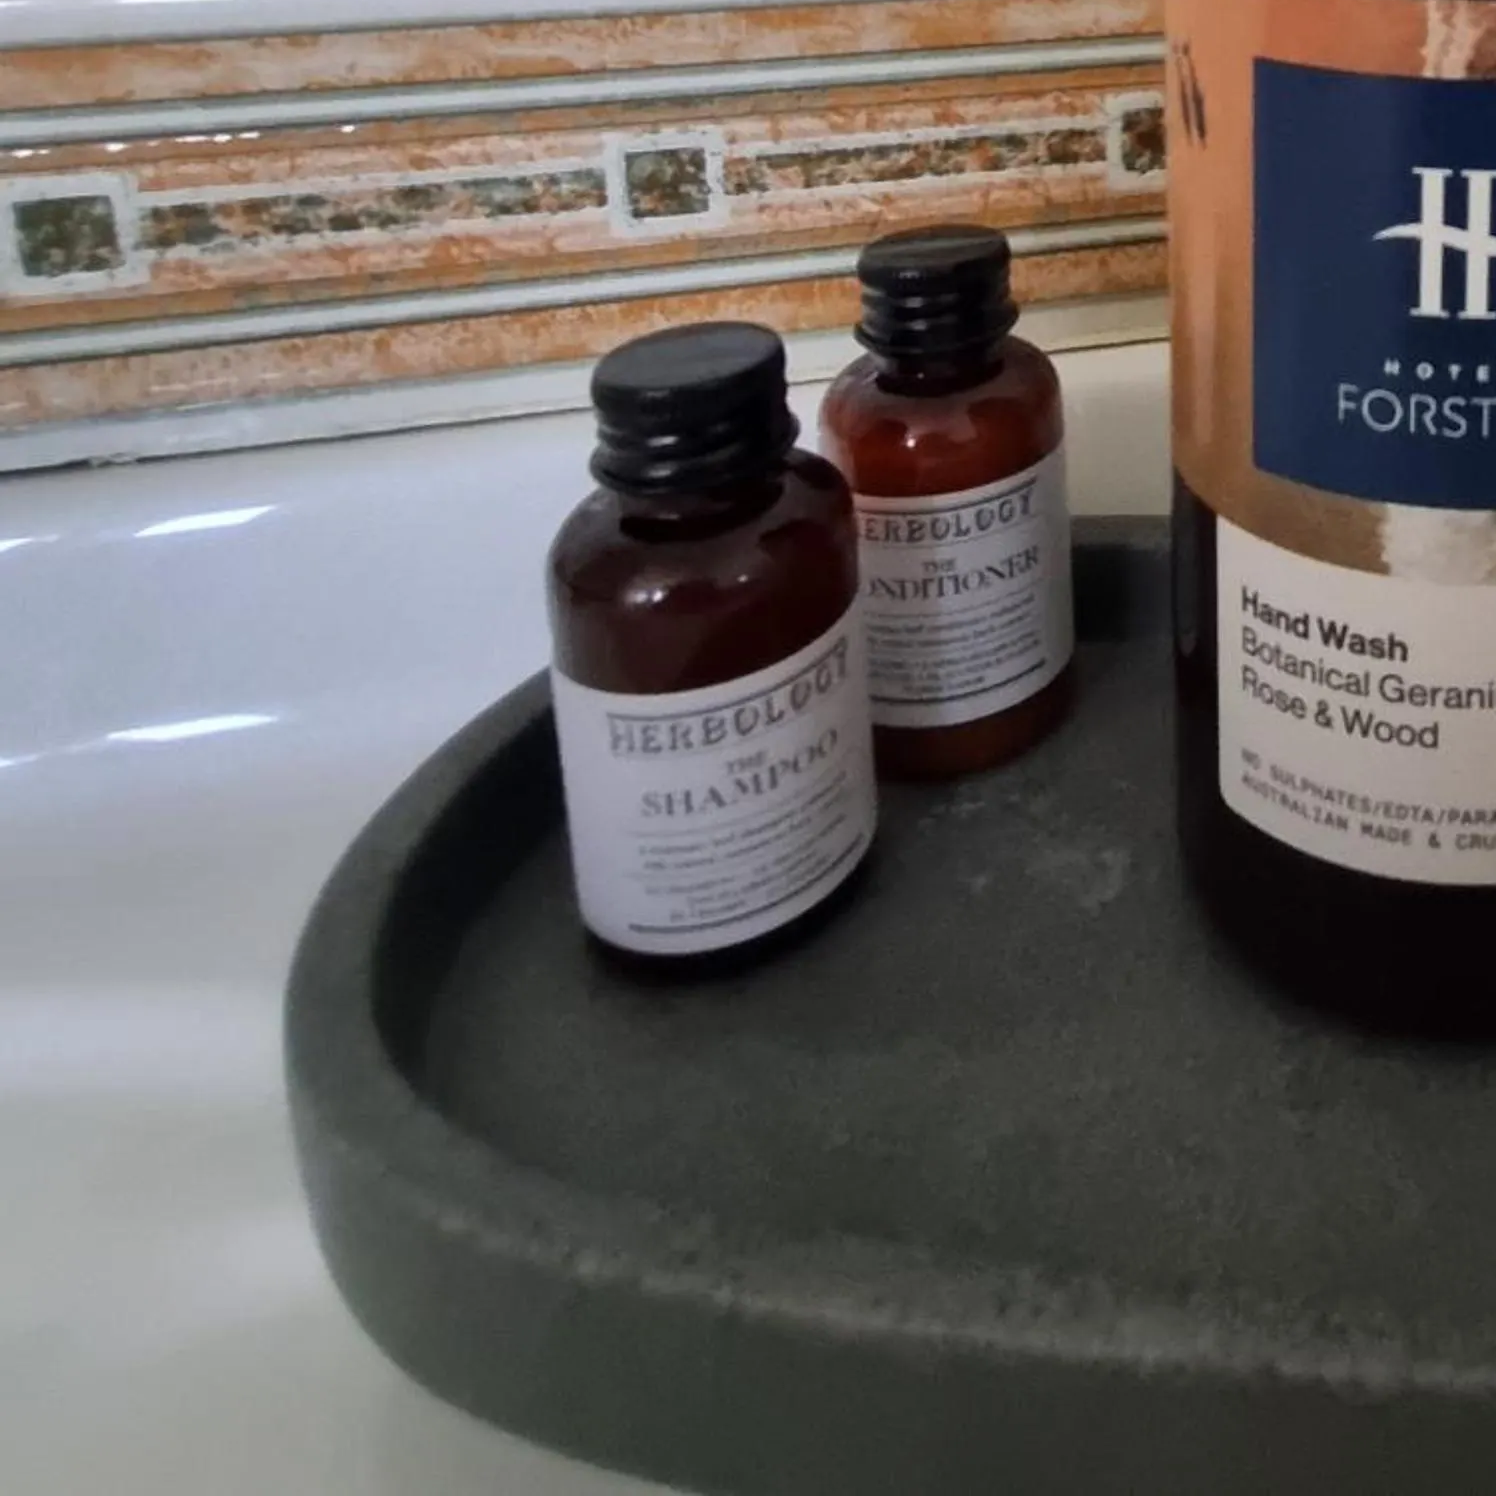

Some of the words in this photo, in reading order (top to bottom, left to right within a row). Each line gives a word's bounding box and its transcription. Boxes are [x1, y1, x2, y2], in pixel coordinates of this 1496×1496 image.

[864, 488, 1032, 543] ERBOLOGY
[869, 545, 1038, 601] NDITIONER
[923, 558, 954, 573] THE
[1242, 586, 1309, 640] Hand
[1317, 616, 1408, 663] Wash
[1242, 625, 1370, 697] Botanical
[607, 637, 848, 754] HERBOLOGY
[1242, 664, 1307, 719] Rose
[1314, 699, 1332, 729] &
[1341, 706, 1439, 749] Wood
[641, 728, 838, 818] SHAMPOO
[1242, 772, 1348, 831] AUSTRALIAN
[1360, 822, 1411, 845] MADE
[1427, 832, 1441, 849] &
